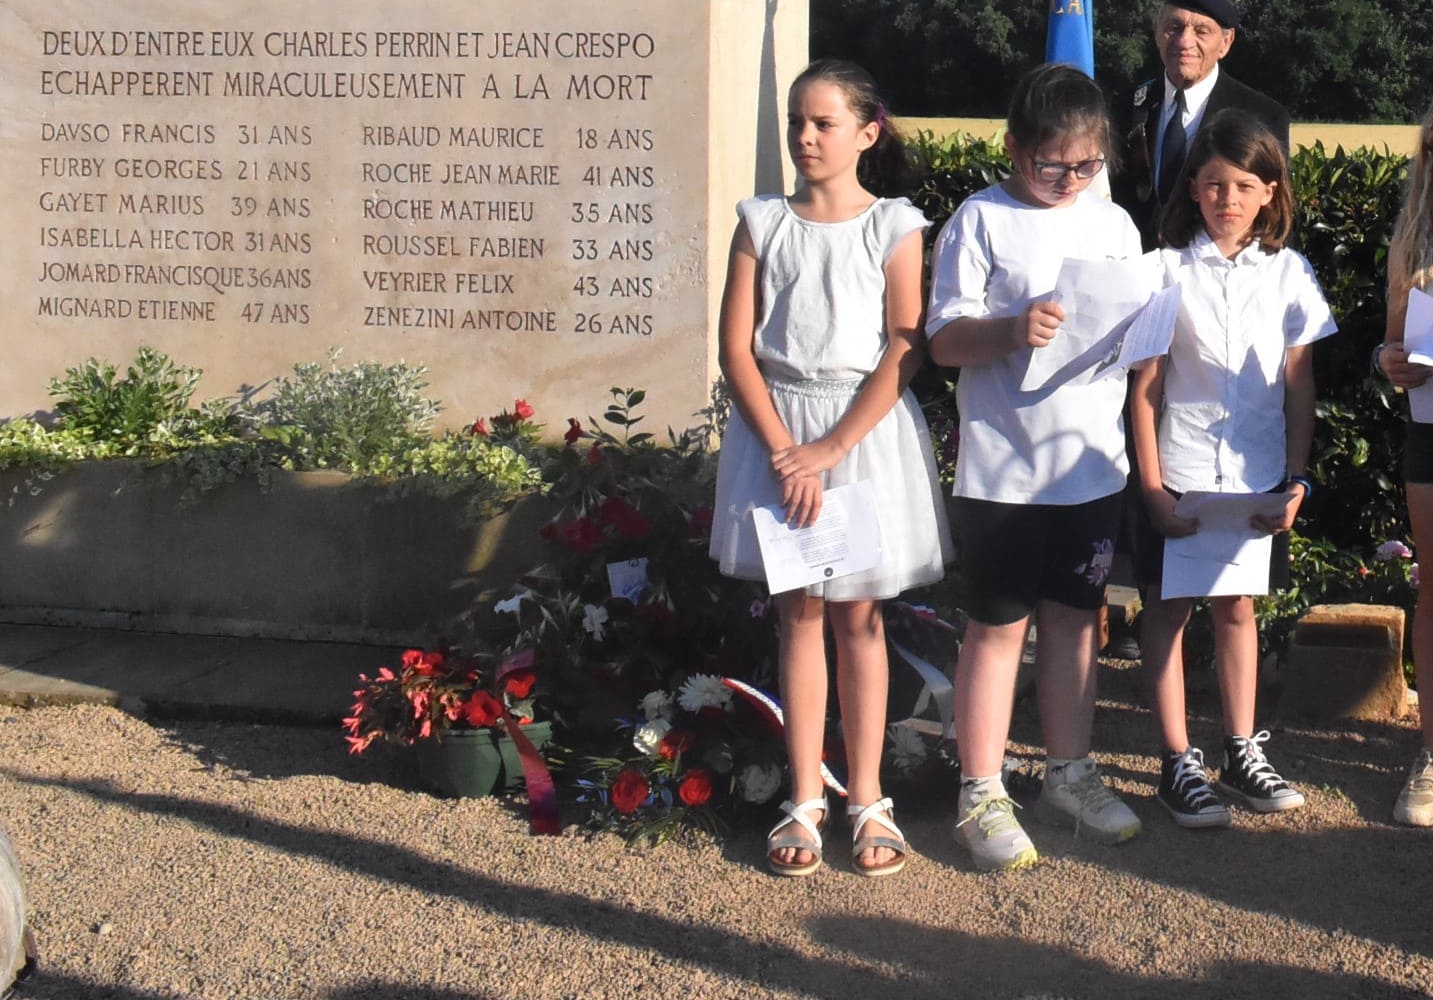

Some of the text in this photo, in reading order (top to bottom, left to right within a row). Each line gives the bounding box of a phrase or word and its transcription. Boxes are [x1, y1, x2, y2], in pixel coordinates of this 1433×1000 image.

[42, 31, 654, 59] DEUX D'ENTRE EUX CHARLES PERRIN ET JEAN CRESPO
[41, 71, 653, 100] ECHAPPERENT MIRACULEUSEMENT A LA MORT
[42, 123, 311, 145] DAVSO FRANCIS 31 ANS
[362, 126, 653, 151] RIBAUD MAURICE 18 ANS
[41, 158, 311, 182] FURBY GEORGES 21 ANS
[362, 163, 654, 187] ROCHE JEAN MARIE 41 ANS
[39, 192, 310, 218] GAYET MARIUS 39 ANS
[363, 199, 653, 224] ROCHE MATHIEU 35 ANS
[41, 227, 311, 254] ISABELLA HECTOR 31 ANS
[364, 235, 653, 261] ROUSSEL FABIEN 33 ANS
[39, 262, 311, 295] JOMARD FRANCISQUE 36 ANS
[363, 271, 652, 298] VEYRIER FELIX 43 ANS
[38, 297, 310, 324] MIGNARD ETIENNE 47 ANS
[364, 307, 653, 335] ZENEZINI ANTOINE 26 ANS
